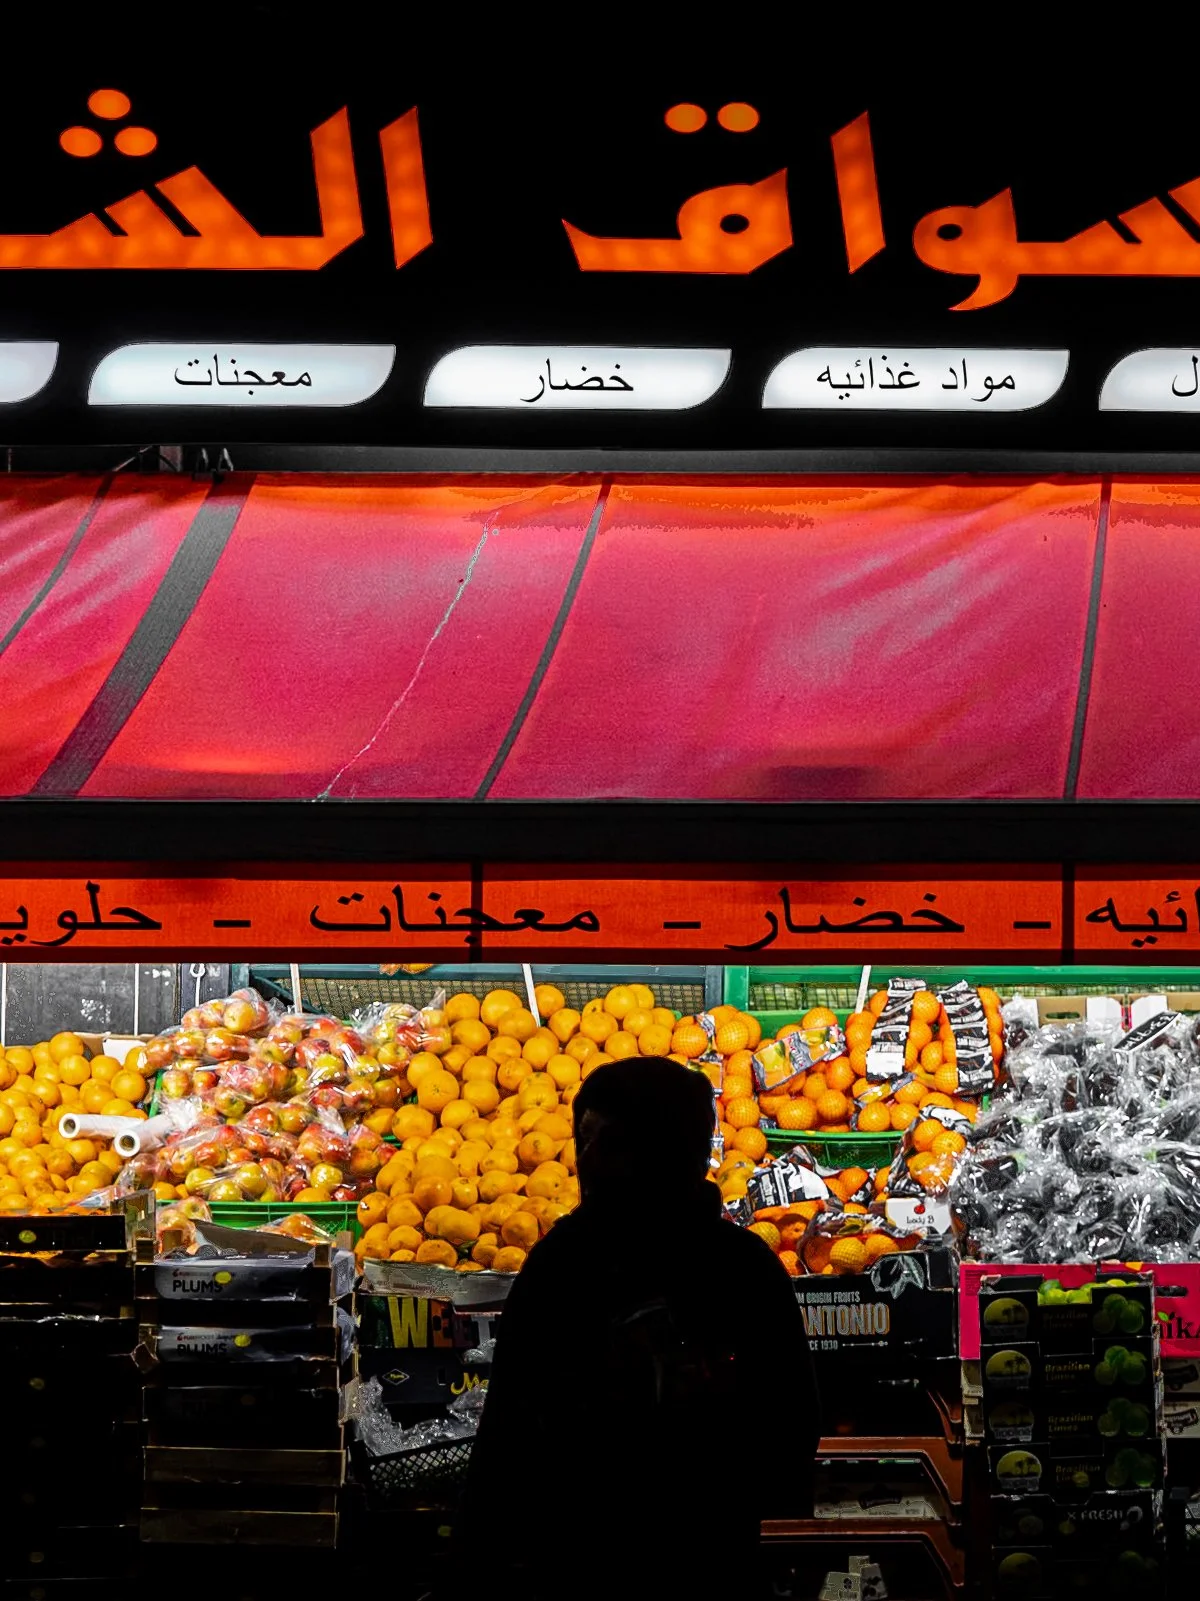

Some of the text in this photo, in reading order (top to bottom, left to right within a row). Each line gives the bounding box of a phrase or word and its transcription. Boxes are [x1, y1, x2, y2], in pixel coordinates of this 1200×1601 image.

[174, 353, 312, 395] معجنات
[519, 358, 635, 403] خضار
[940, 357, 1017, 403] مواد
[308, 883, 602, 945] معجنات
[723, 887, 966, 952] خضار
[172, 1279, 223, 1293] PLUMS
